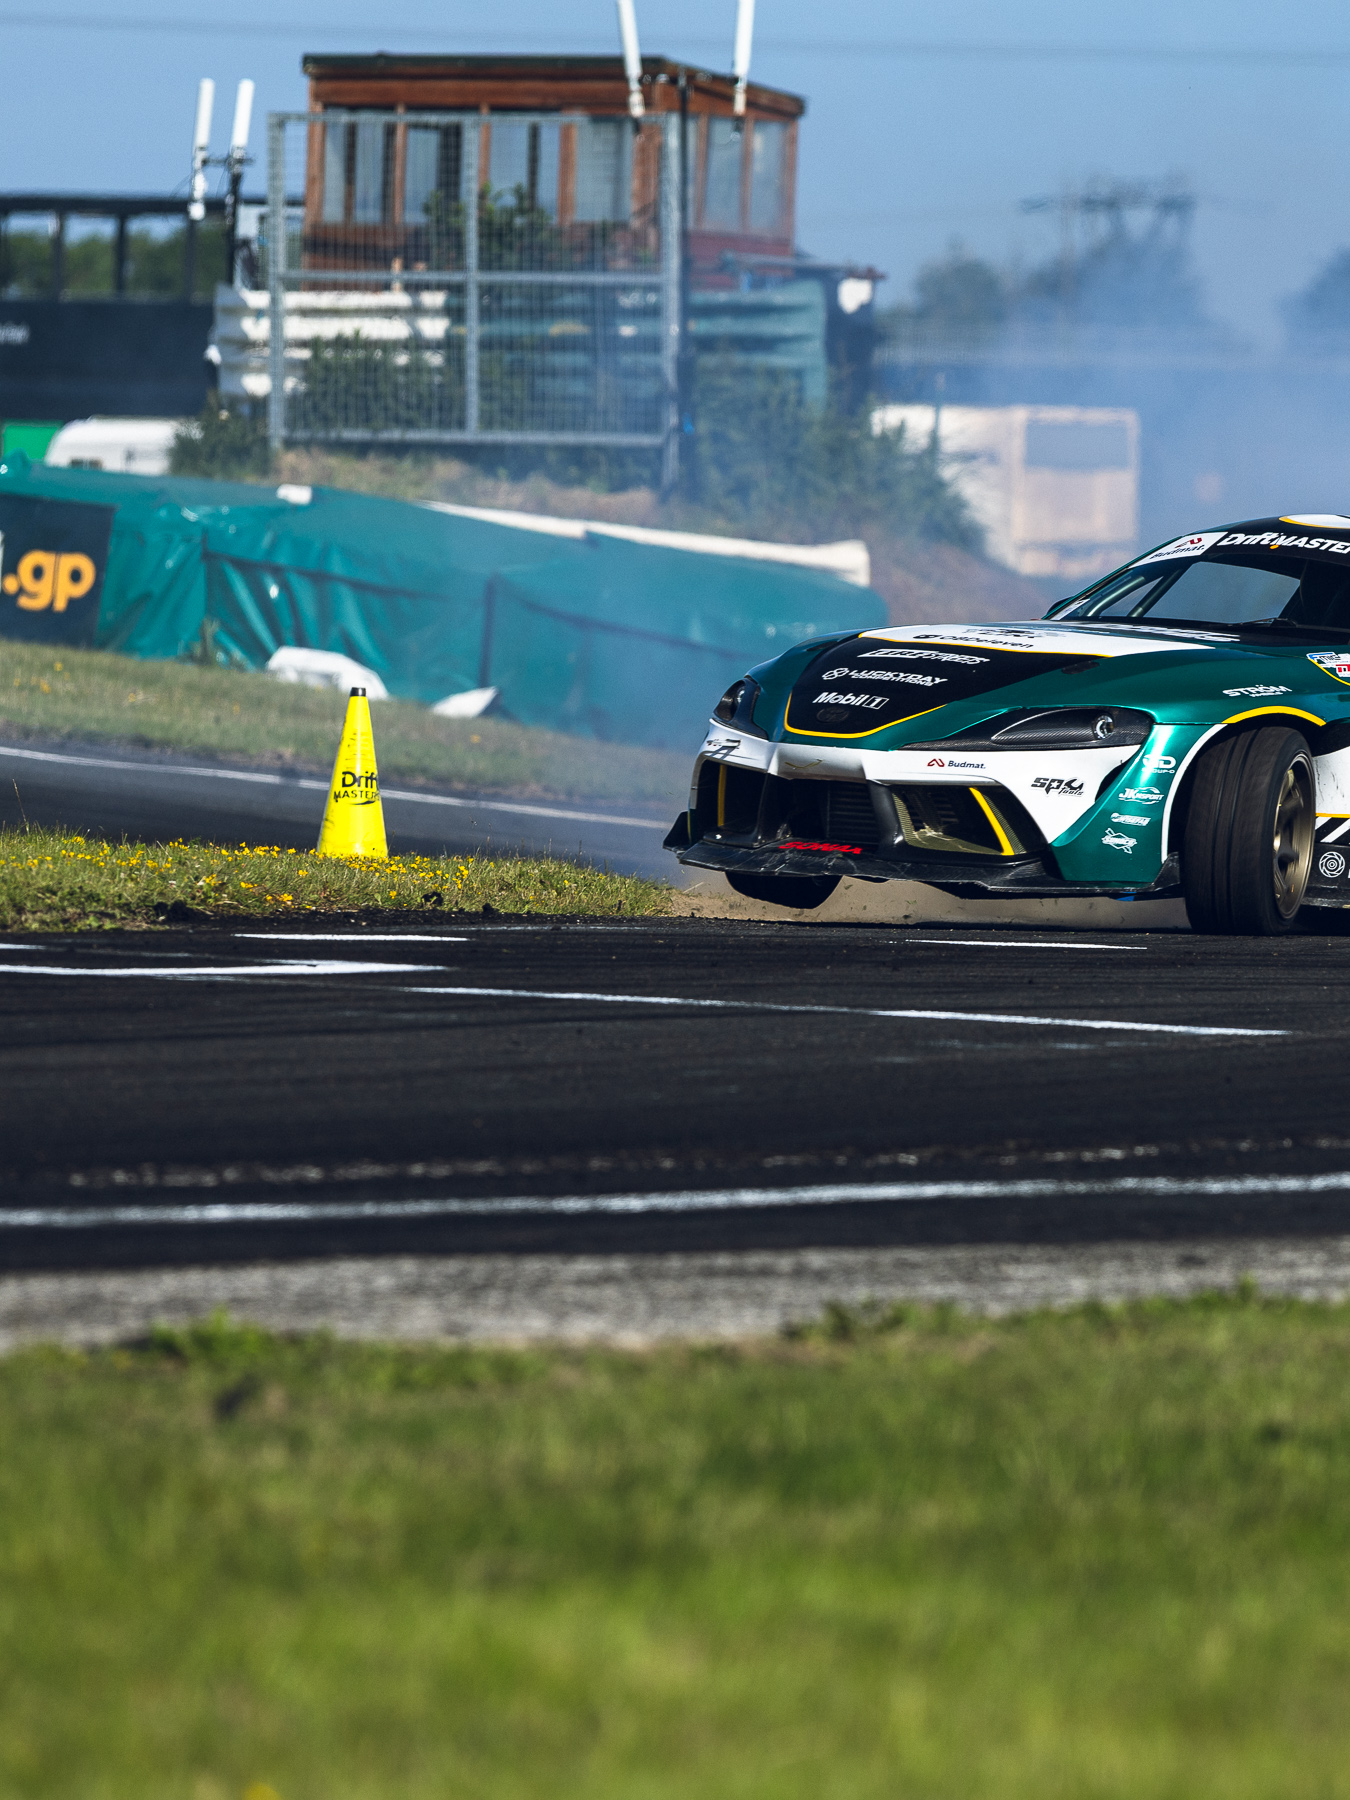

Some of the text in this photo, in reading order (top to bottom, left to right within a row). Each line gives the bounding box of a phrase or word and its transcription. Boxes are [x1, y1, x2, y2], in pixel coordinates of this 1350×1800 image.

[1216, 533, 1280, 547] Drift
[0, 530, 96, 613] .gp
[849, 669, 948, 685] LUCKYDAY
[812, 692, 868, 706] Mobil
[778, 841, 862, 855] SONAX
